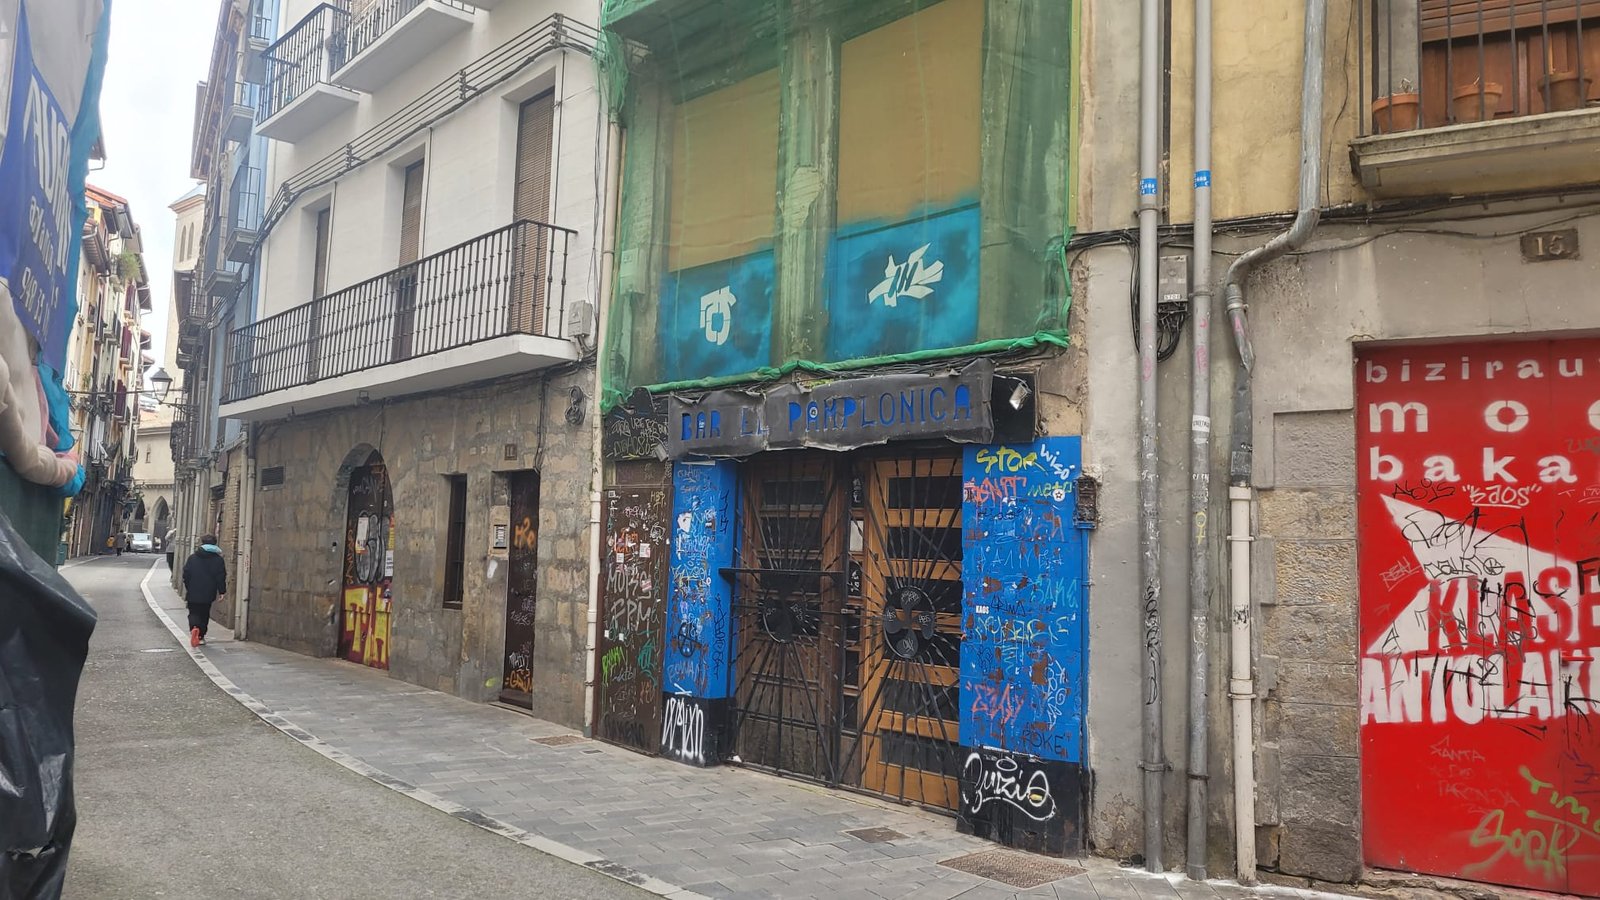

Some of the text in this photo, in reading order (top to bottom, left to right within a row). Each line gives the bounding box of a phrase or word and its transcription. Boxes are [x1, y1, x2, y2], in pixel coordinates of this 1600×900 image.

[1366, 355, 1600, 383] bizirau
[681, 410, 720, 441] BAR
[787, 384, 972, 432] PAMPLONICA
